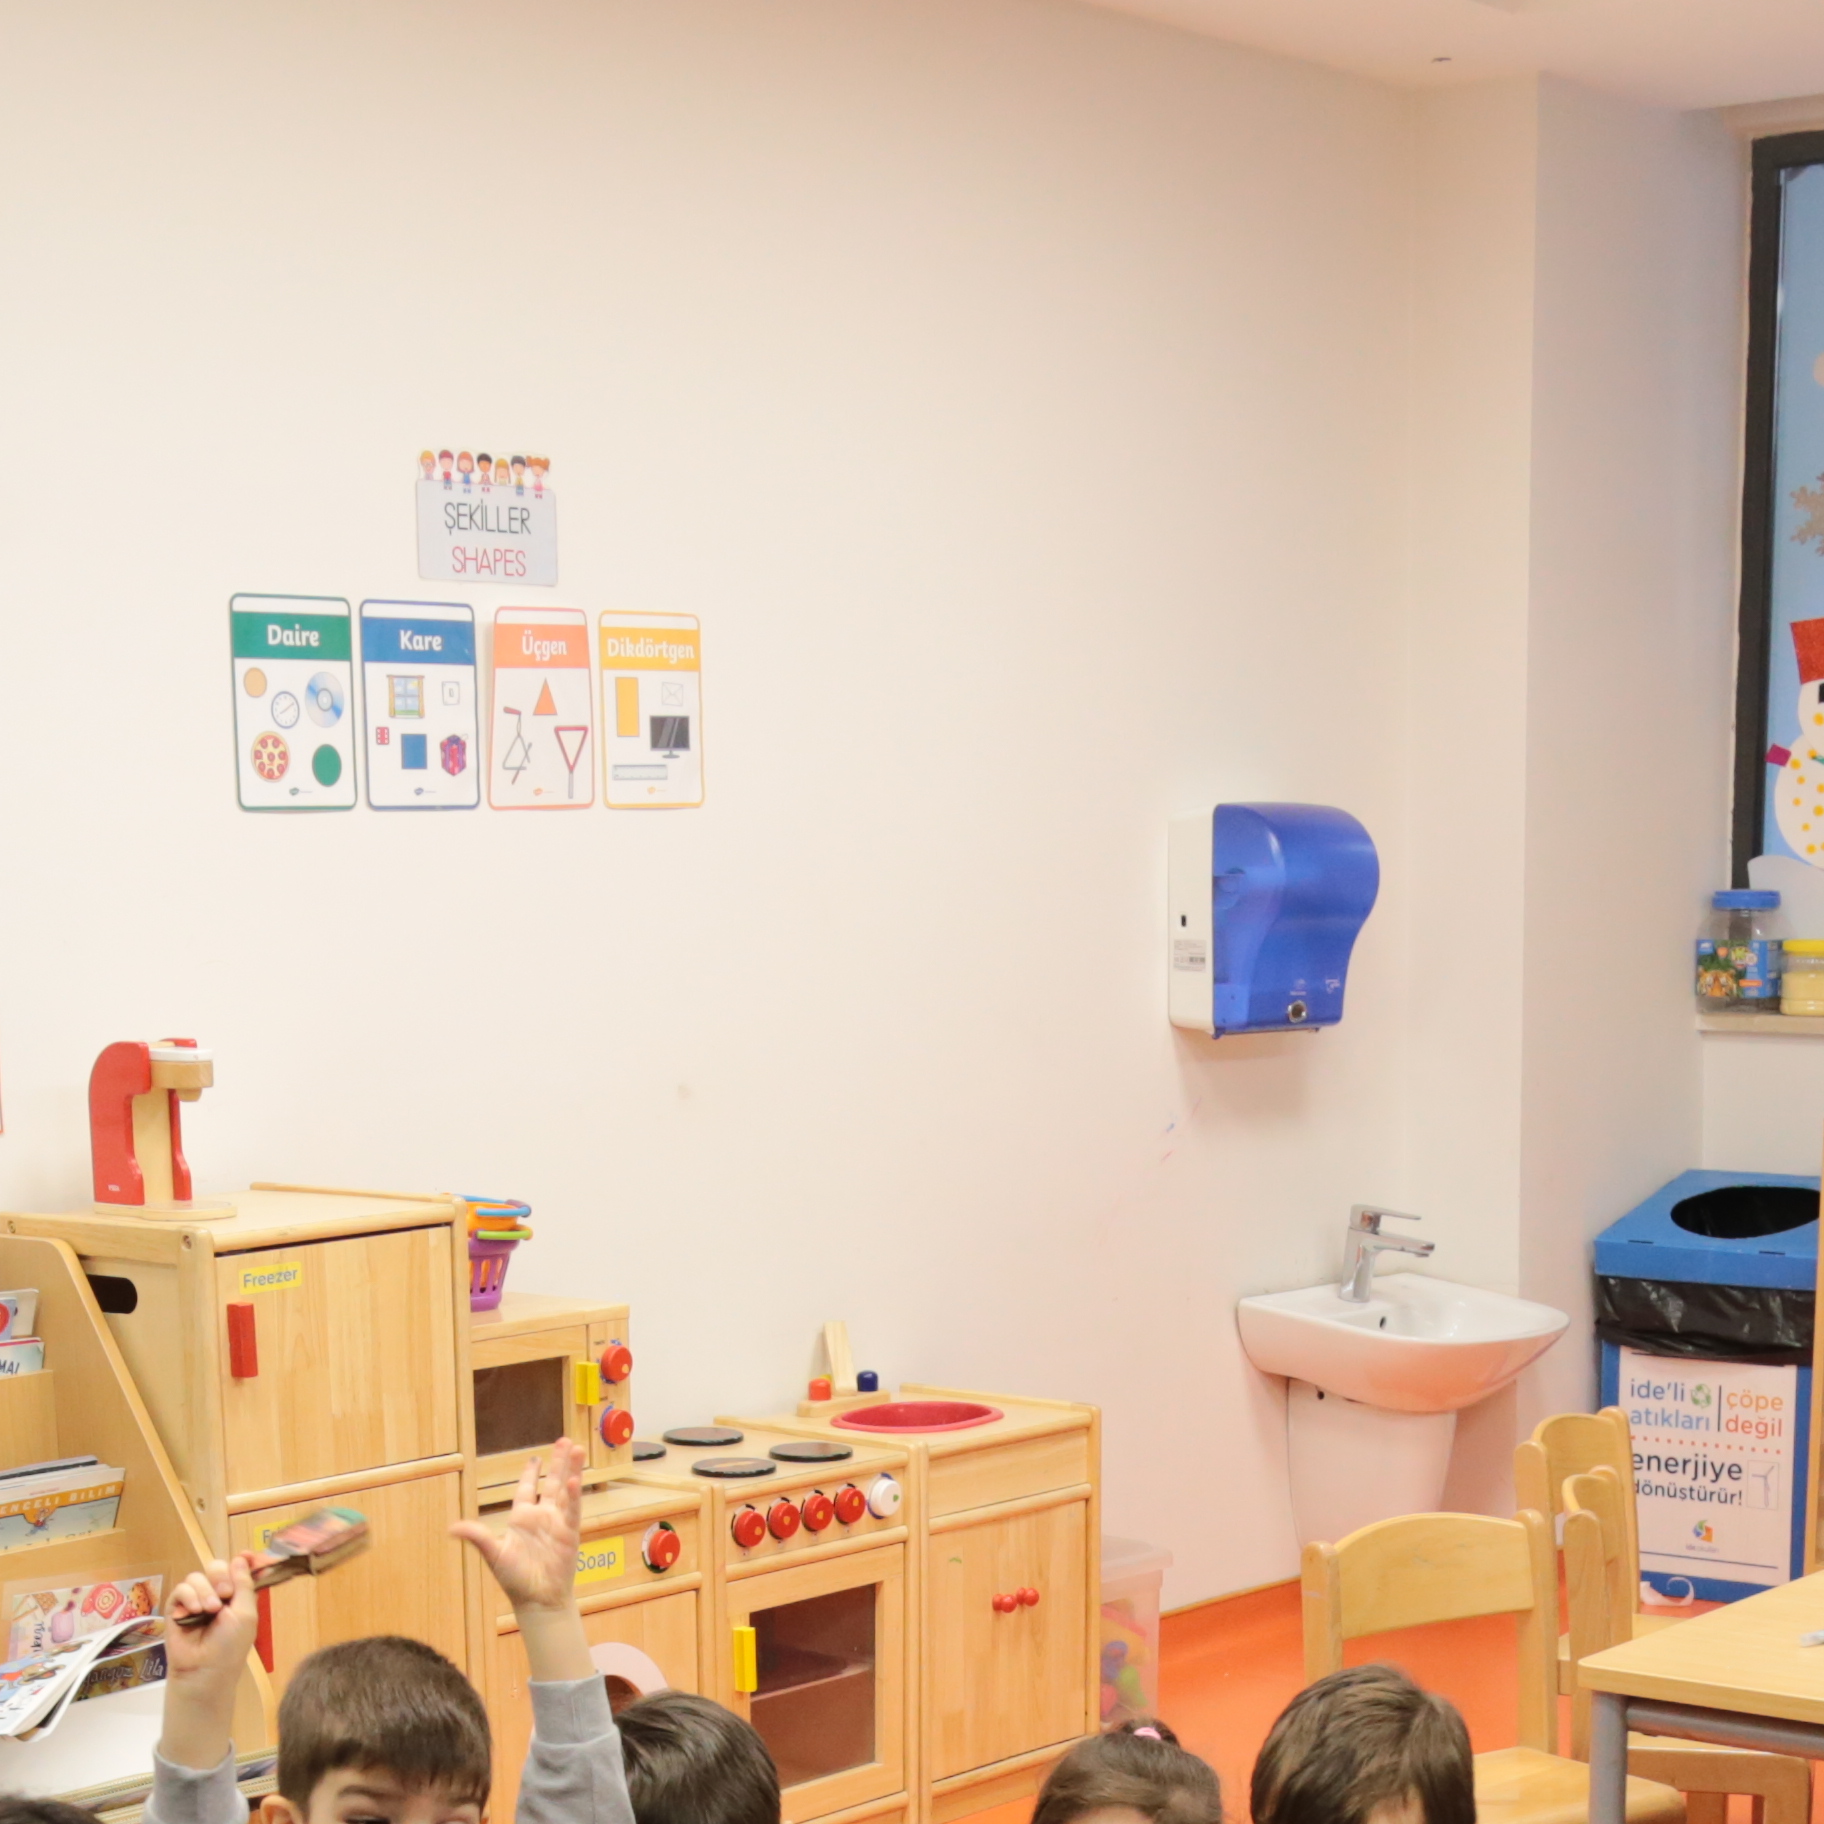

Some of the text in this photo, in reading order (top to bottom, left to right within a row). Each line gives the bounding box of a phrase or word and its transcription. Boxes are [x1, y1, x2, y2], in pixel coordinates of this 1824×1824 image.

[444, 498, 531, 536] ŞEKİLLER
[451, 546, 526, 577] SHAPES
[267, 623, 320, 649] Daire
[399, 629, 442, 653] Kare
[522, 633, 567, 663] Üçgen
[607, 638, 695, 664] Dikdörtgen
[243, 1269, 298, 1288] Freezer
[1631, 1379, 1685, 1401] ide'li
[1727, 1389, 1784, 1412] çöpe
[1630, 1407, 1710, 1431] atıkları
[1725, 1415, 1782, 1439] değil
[1633, 1452, 1743, 1483] enerjiye
[576, 1551, 616, 1572] Soap
[140, 1657, 164, 1682] Lila
